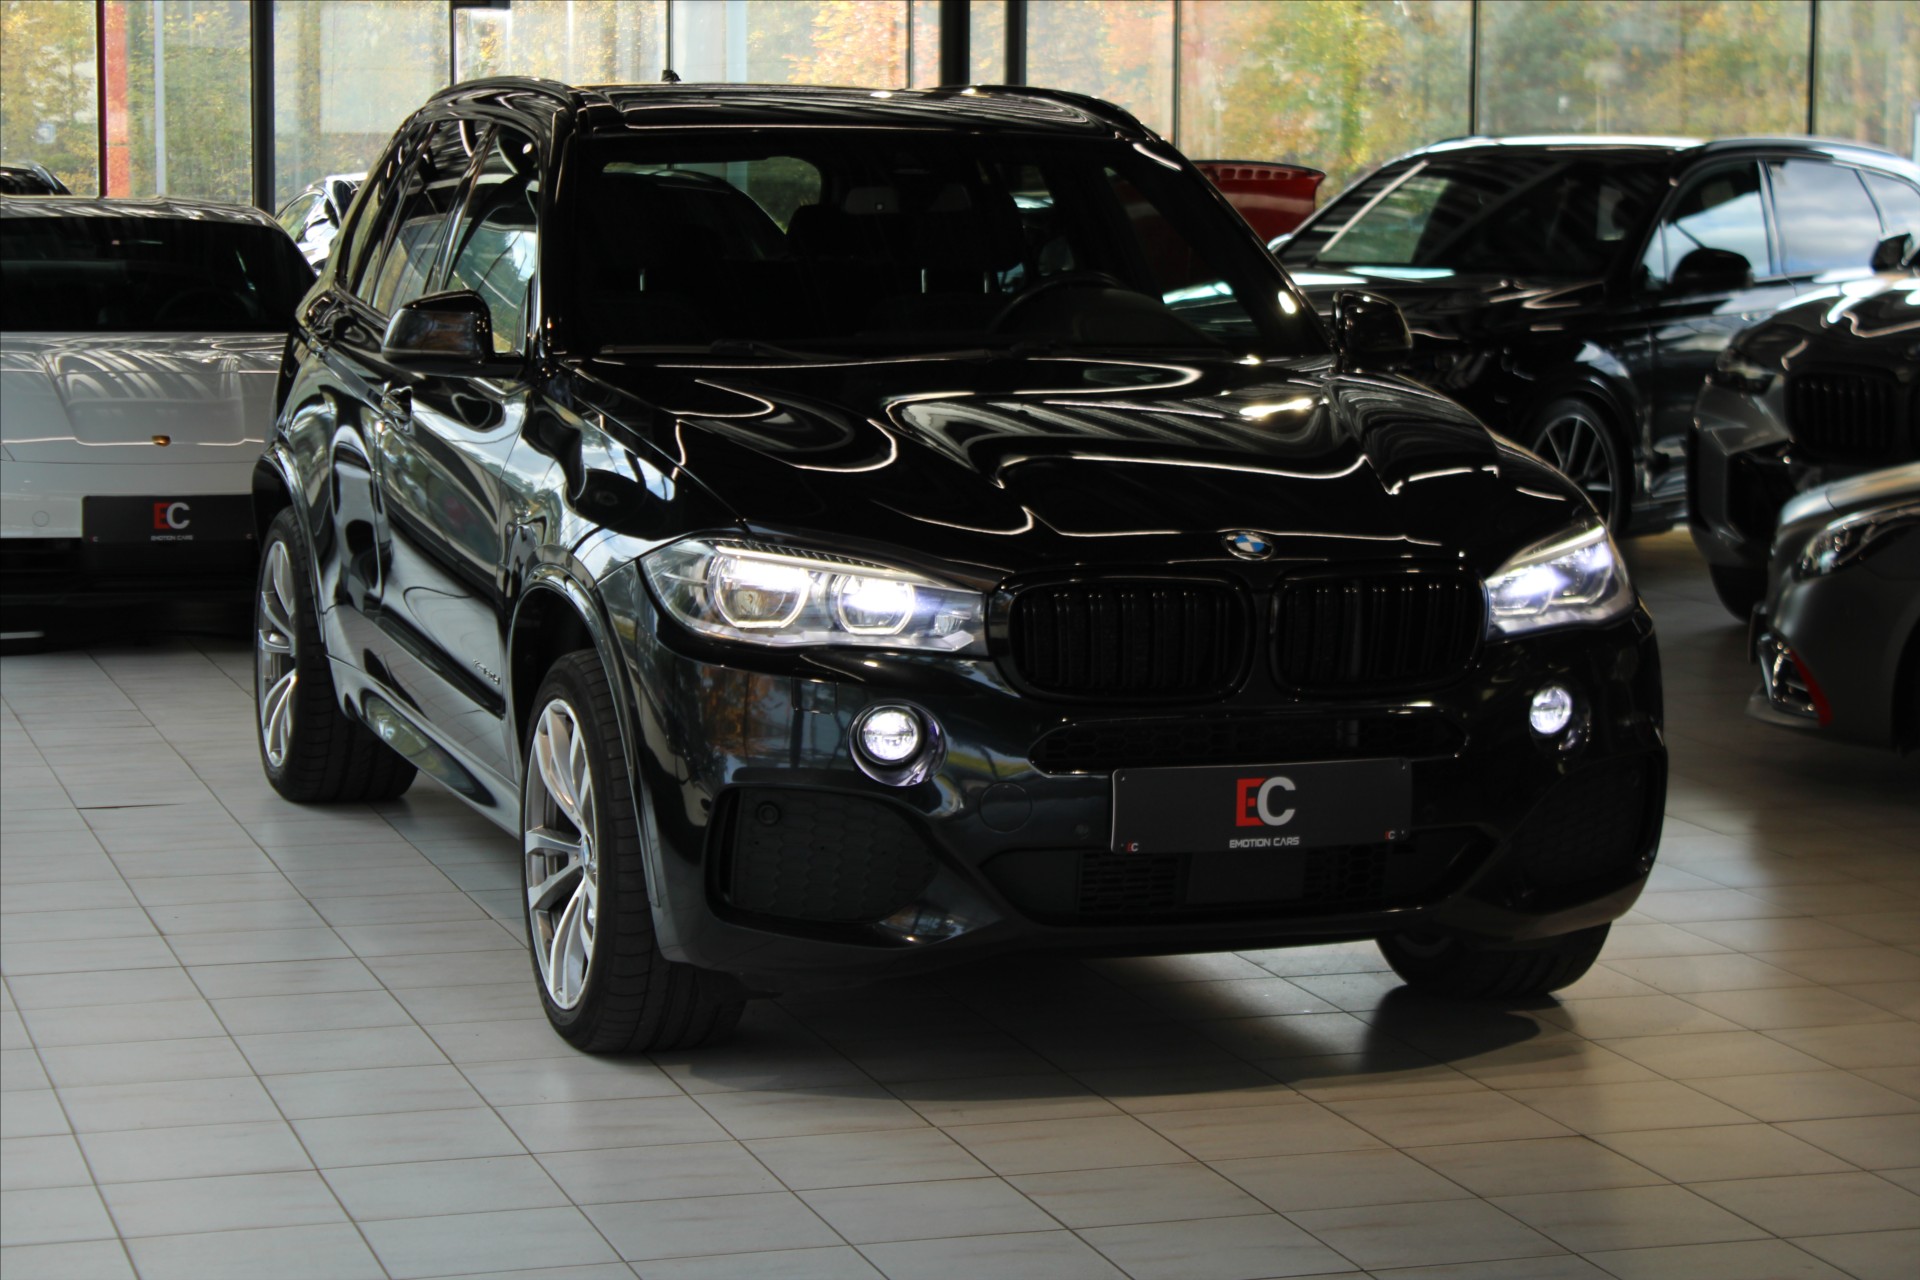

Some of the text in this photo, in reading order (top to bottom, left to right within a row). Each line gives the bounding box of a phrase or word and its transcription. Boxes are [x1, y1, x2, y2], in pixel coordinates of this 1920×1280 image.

[153, 502, 190, 530] EC
[1235, 776, 1296, 827] EC
[1229, 836, 1300, 849] EMOTION CARS
